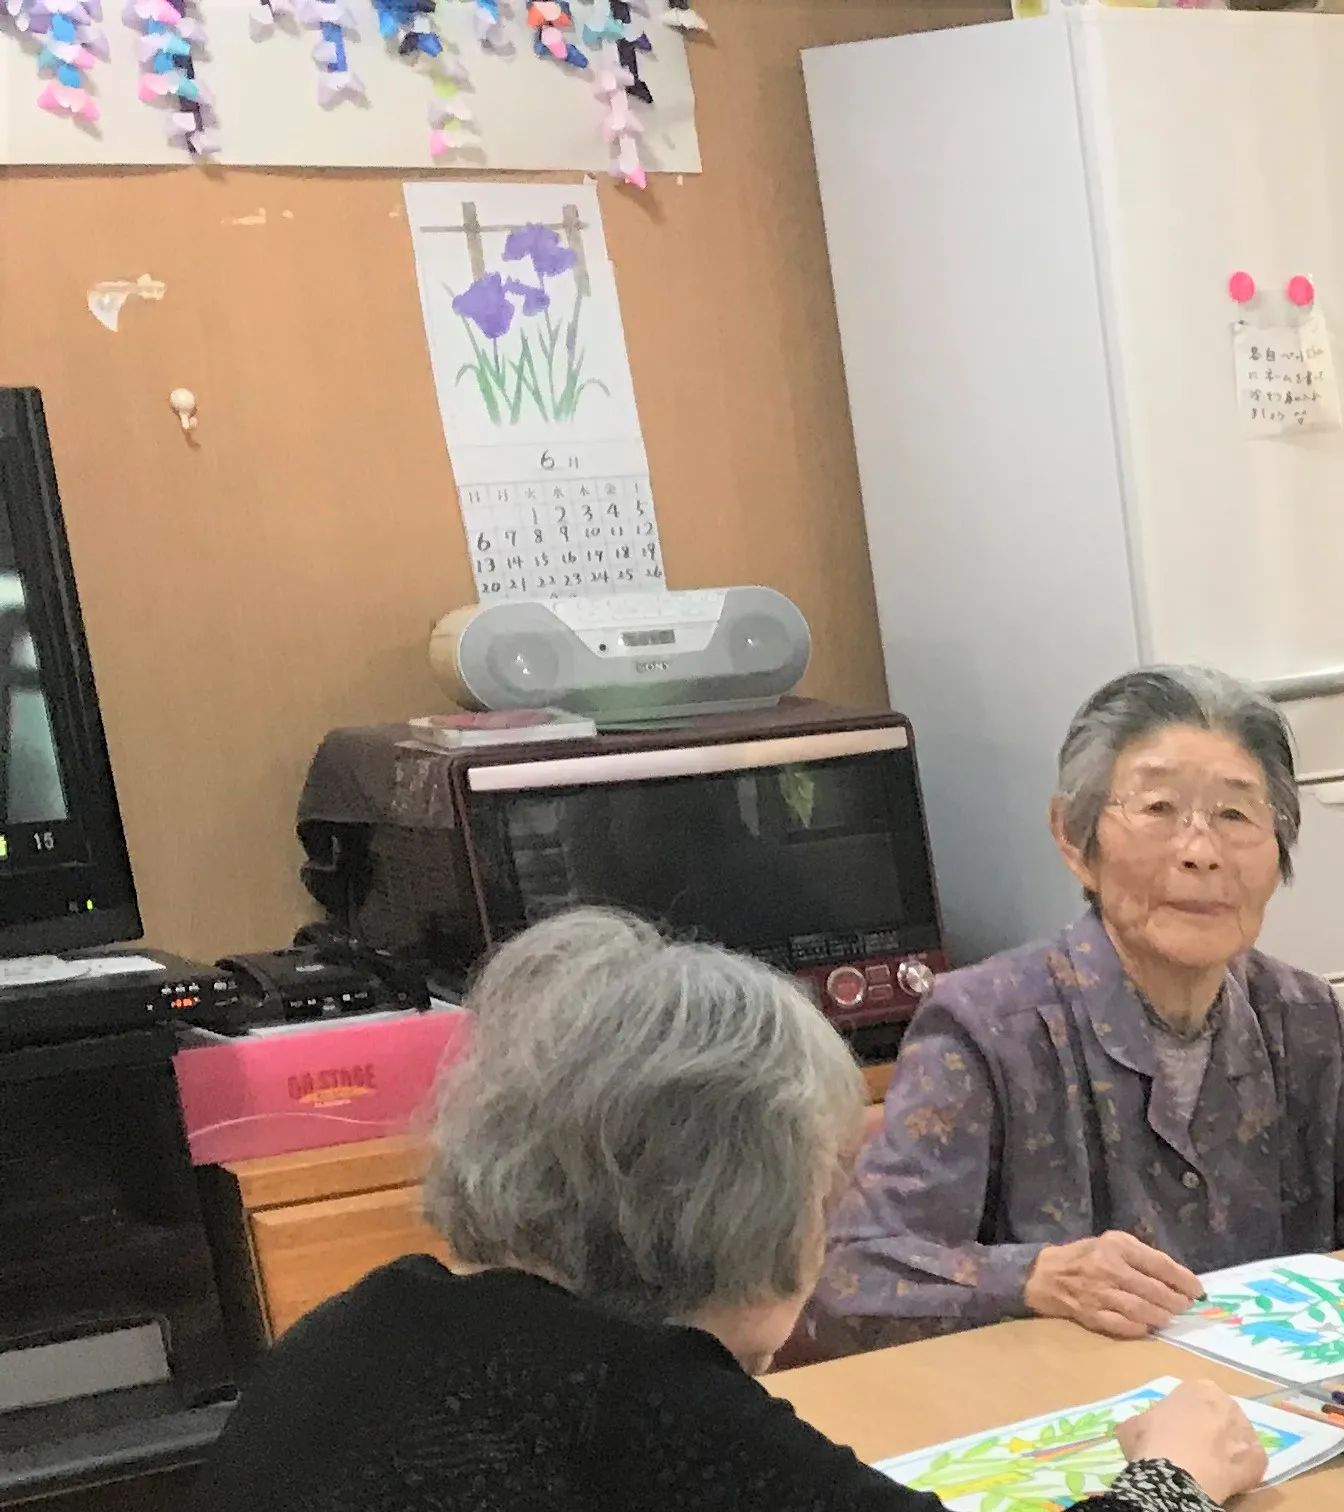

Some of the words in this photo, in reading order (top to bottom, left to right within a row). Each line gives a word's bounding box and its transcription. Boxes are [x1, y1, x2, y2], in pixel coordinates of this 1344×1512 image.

[531, 506, 538, 525] 1
[554, 505, 566, 523] 2
[581, 504, 593, 521] 3
[606, 502, 619, 518] 4
[636, 499, 649, 516] 5
[477, 531, 491, 551] 6
[504, 529, 517, 547] 7
[533, 528, 543, 544] 8
[559, 525, 569, 542] 9
[585, 527, 601, 539] 10
[610, 526, 623, 537] 11
[636, 521, 656, 536] 12
[477, 556, 496, 573] 13
[506, 555, 524, 569] 14
[534, 551, 549, 567] 15
[561, 550, 577, 564] 16
[587, 550, 603, 562] 17
[615, 544, 630, 559] 18
[641, 542, 656, 560] 19
[482, 581, 501, 593] 20
[508, 576, 527, 592] 21
[538, 575, 557, 588] 22
[563, 572, 582, 586] 23
[590, 568, 609, 583] 24
[616, 567, 634, 580] 25
[645, 564, 663, 578] 26
[33, 831, 55, 850] 15
